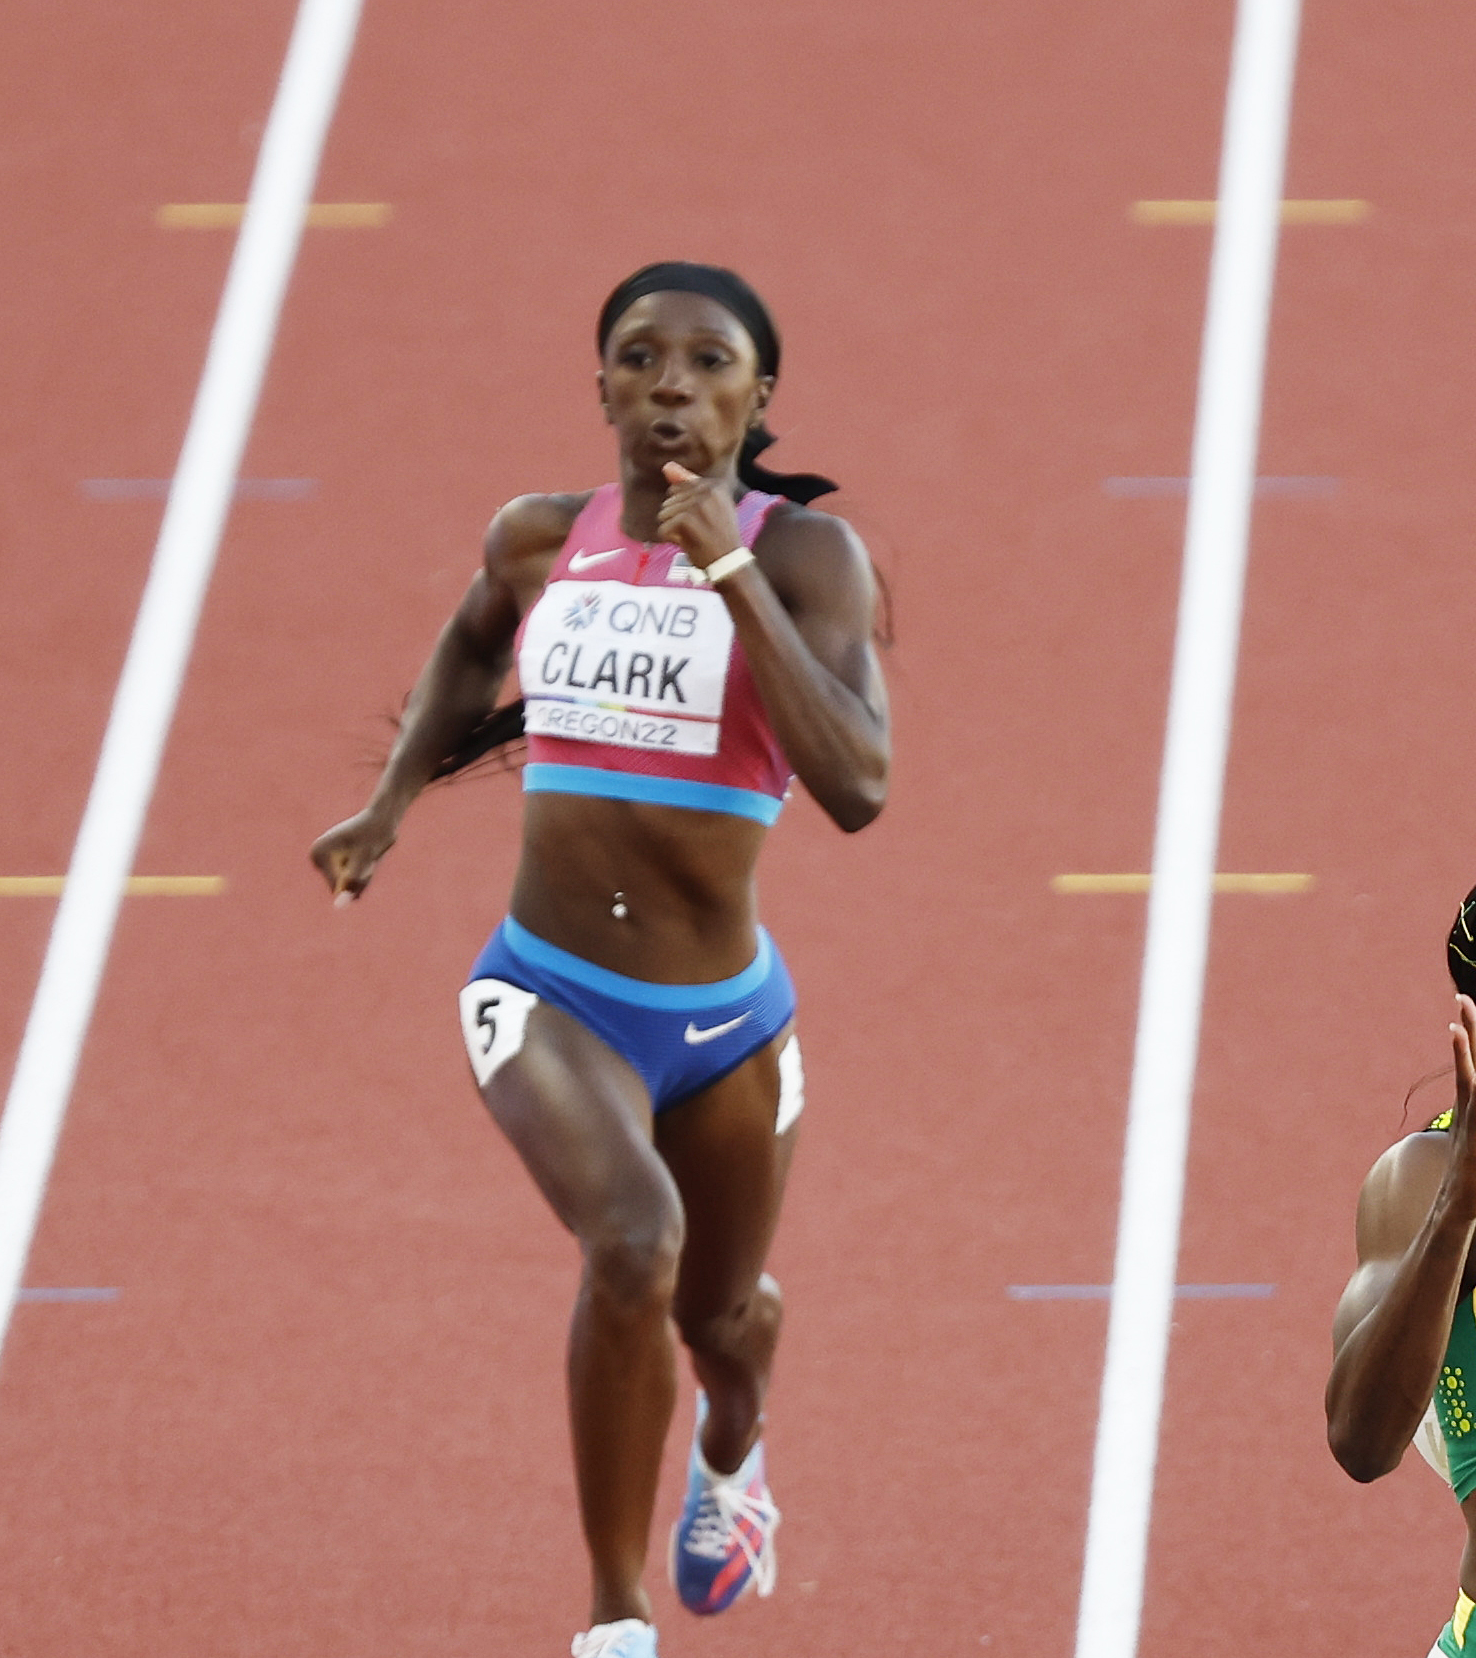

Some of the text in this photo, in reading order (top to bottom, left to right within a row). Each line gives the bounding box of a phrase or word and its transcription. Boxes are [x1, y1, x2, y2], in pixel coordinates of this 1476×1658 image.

[609, 600, 699, 638] QNB
[541, 641, 691, 704] CLARK
[476, 997, 501, 1056] 5
